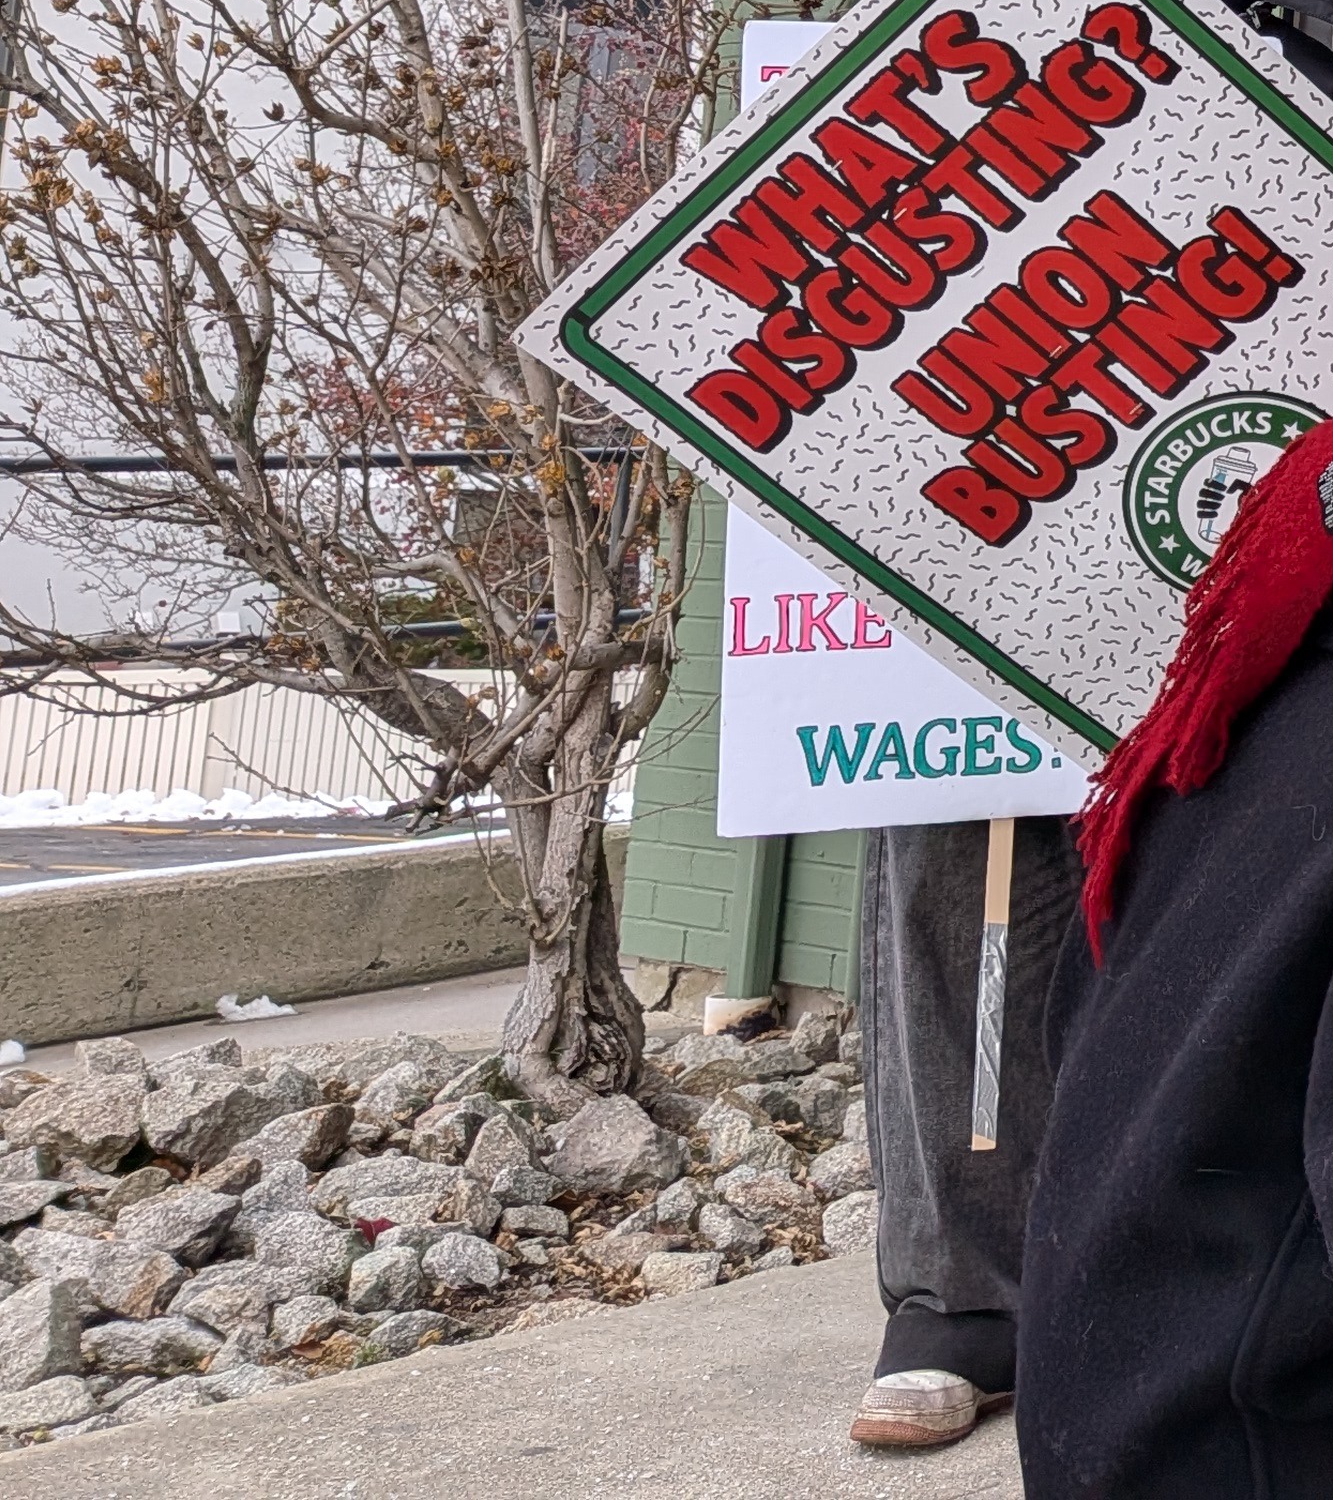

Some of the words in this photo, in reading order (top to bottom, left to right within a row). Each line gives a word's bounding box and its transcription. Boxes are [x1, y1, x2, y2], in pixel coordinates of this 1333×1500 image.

[681, 8, 1029, 310] WHAT'S
[684, 1, 1181, 454] DISGUSTING?
[891, 187, 1181, 443] UNION
[920, 205, 1307, 548] BUSTING!
[1145, 411, 1273, 526] STARBUCKS
[728, 592, 892, 657] LIKE
